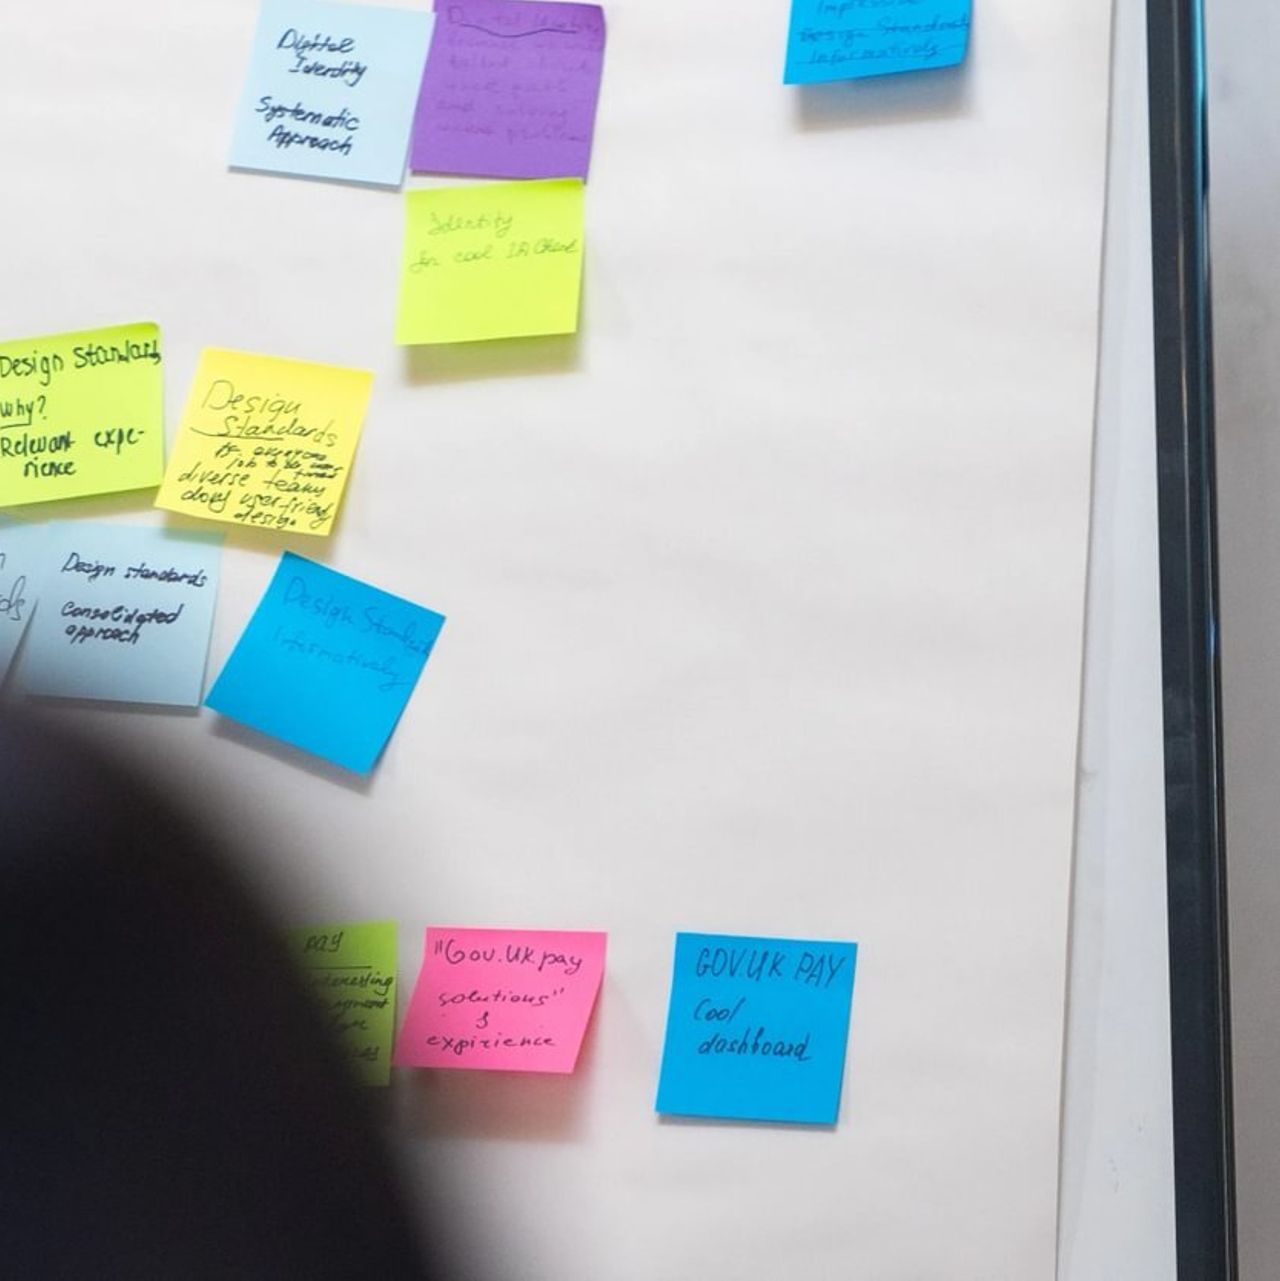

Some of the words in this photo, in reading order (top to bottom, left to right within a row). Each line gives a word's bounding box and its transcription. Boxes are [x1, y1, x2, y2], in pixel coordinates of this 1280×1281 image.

[255, 96, 360, 131] Systematic
[267, 124, 353, 156] Approach
[201, 379, 301, 422] Design
[1, 431, 75, 458] Relevant
[218, 415, 338, 447] Standards
[23, 456, 77, 478] rience
[178, 462, 251, 488] diverse
[61, 552, 115, 582] Design
[124, 562, 207, 587] standards
[283, 576, 354, 629] Design
[65, 624, 139, 645] approach
[537, 951, 583, 975] pay
[795, 951, 846, 988] PAY
[694, 997, 747, 1024] Cool
[698, 1027, 812, 1061] dashboard
